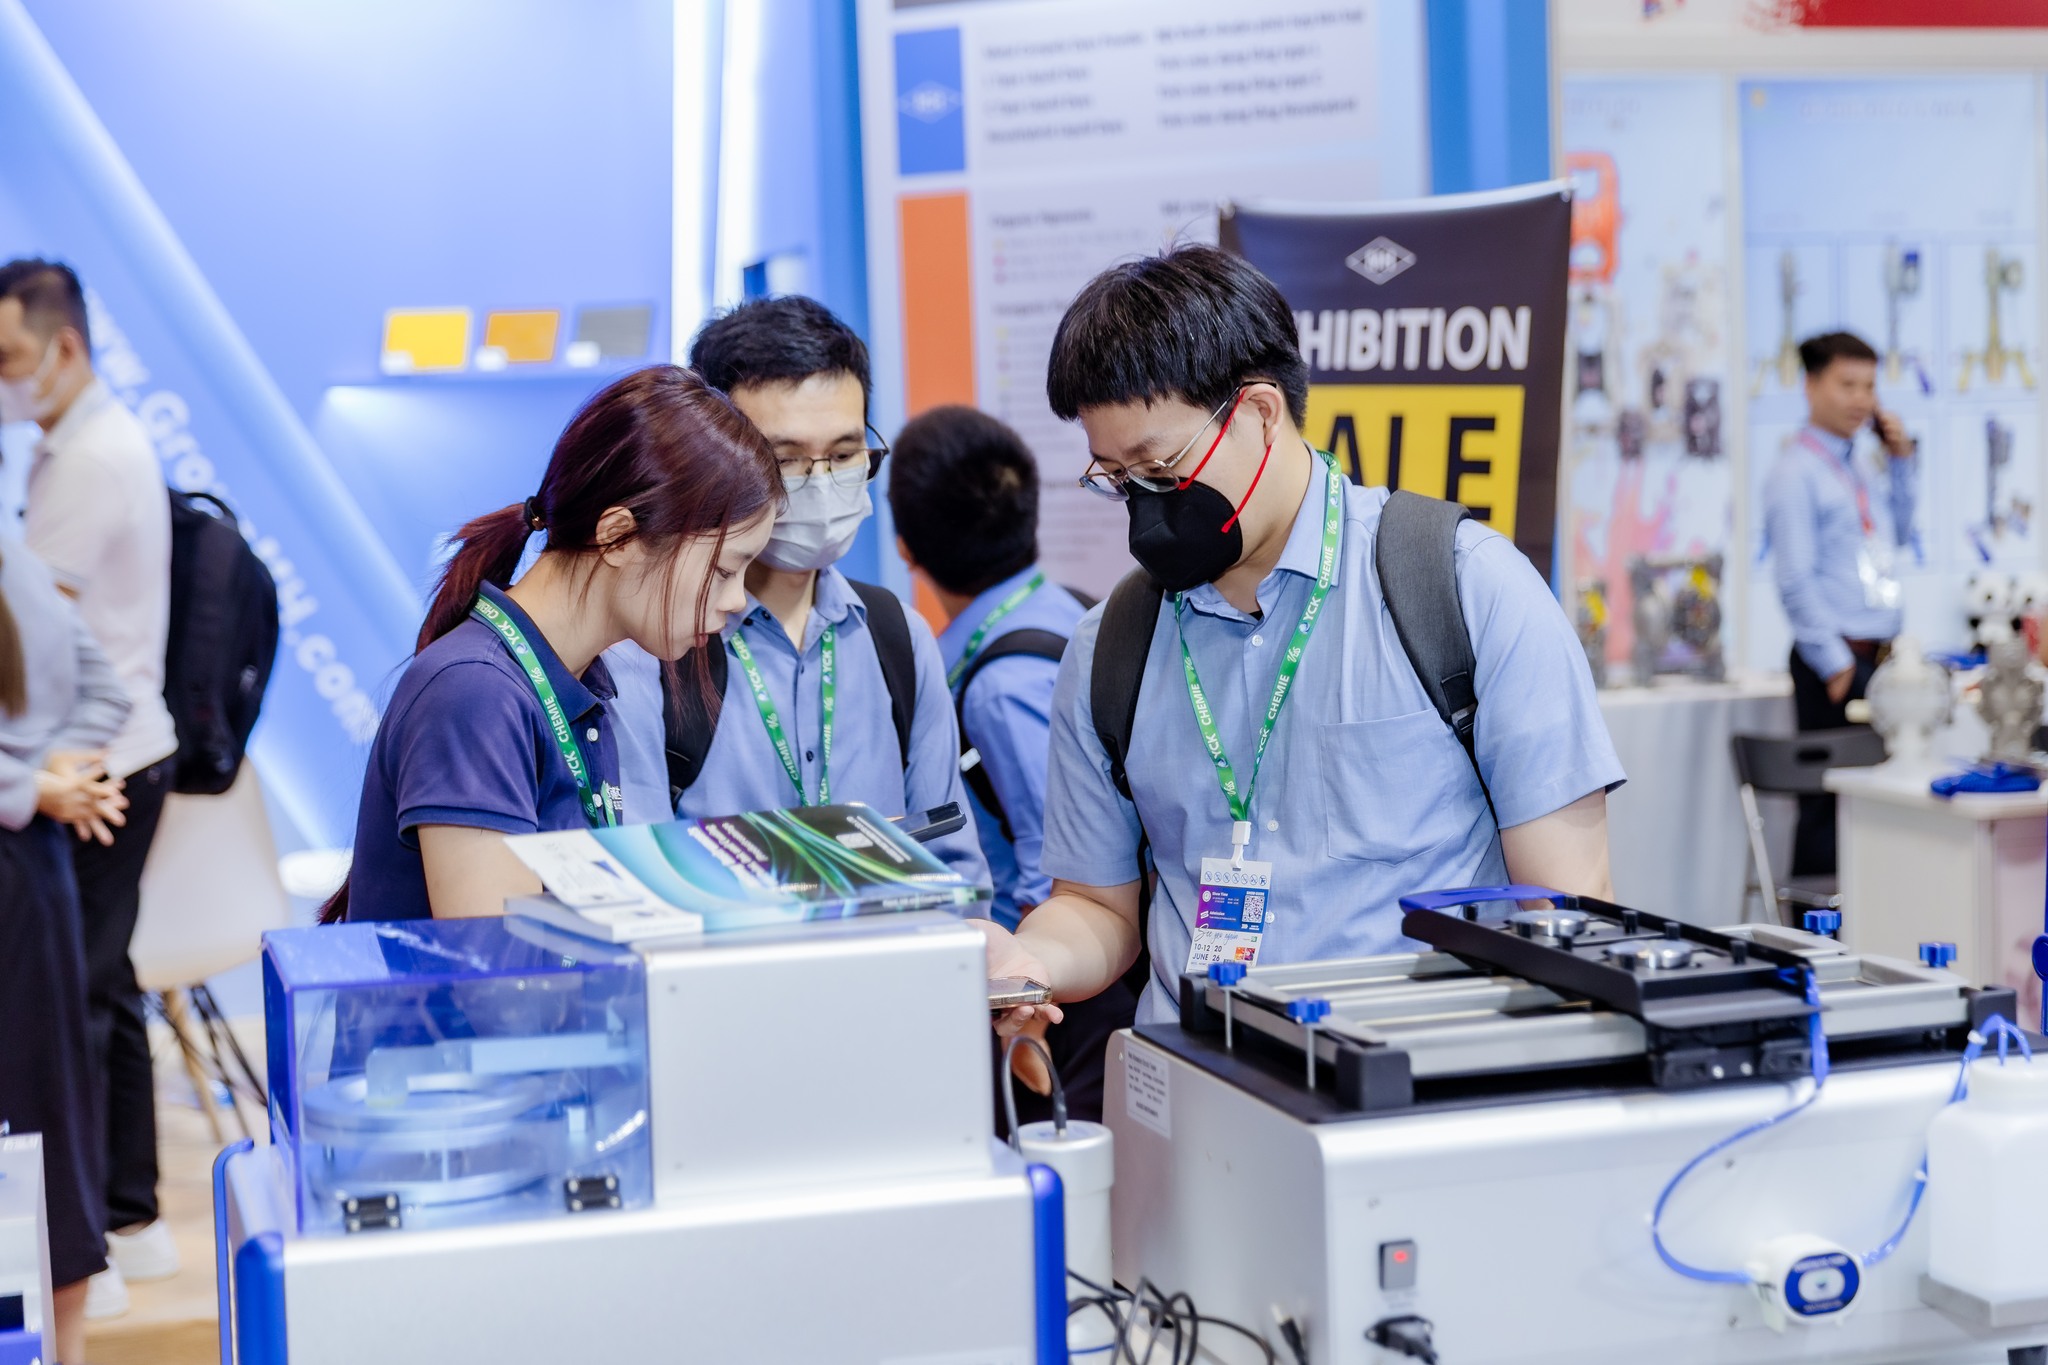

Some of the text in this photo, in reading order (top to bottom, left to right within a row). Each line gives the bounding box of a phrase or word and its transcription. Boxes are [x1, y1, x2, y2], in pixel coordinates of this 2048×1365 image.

[1293, 304, 1531, 371] HIBITION
[1327, 416, 1497, 522] ALE
[1258, 727, 1270, 754] YCK
[1268, 673, 1290, 720] CHEMIE
[1303, 596, 1321, 621] YCK
[1318, 545, 1334, 589] CHEMIE
[1330, 472, 1339, 495] YCK
[497, 620, 520, 646] YCK
[822, 649, 833, 673] YCK
[747, 667, 764, 692] YCK
[1190, 683, 1212, 726] CHEMIE
[543, 695, 570, 743] CHEMIE
[775, 738, 798, 781] CHEMIE
[1205, 733, 1222, 759] YCK
[564, 750, 582, 778] YCK
[1192, 952, 1221, 962] JUNE 26
[1194, 943, 1223, 953] 10-12 20
